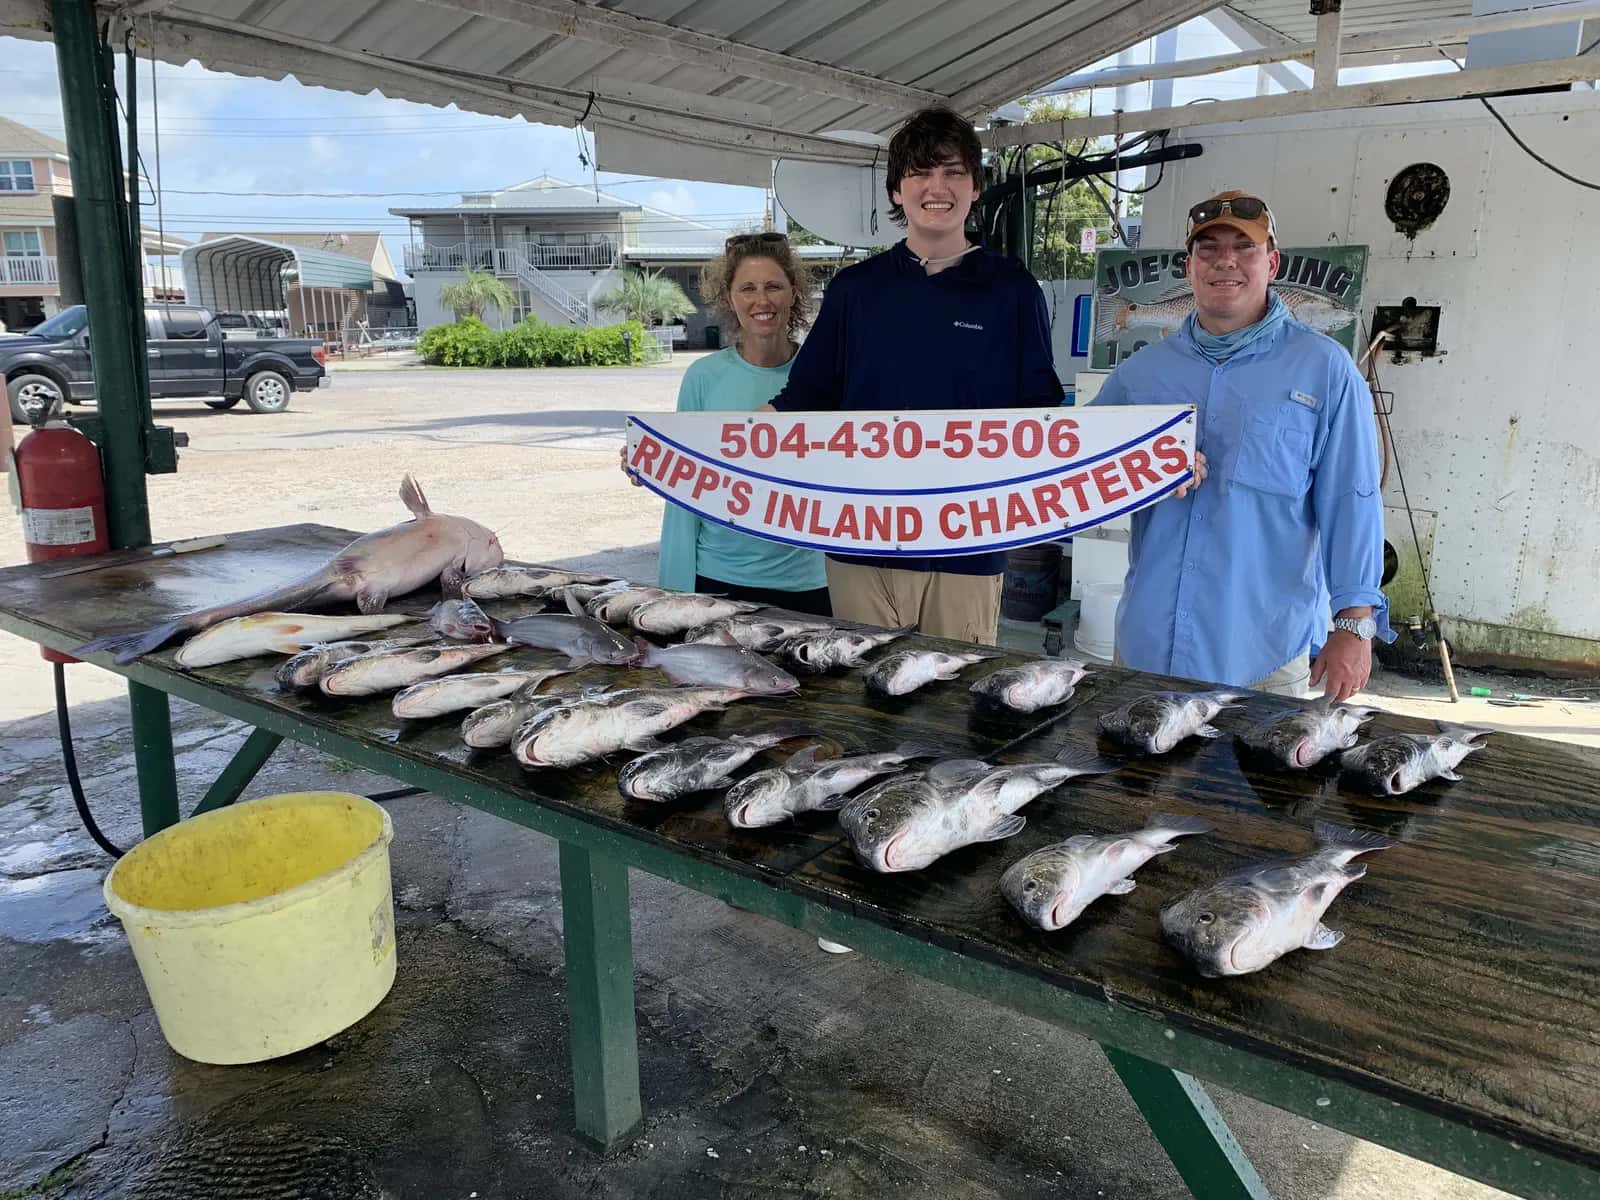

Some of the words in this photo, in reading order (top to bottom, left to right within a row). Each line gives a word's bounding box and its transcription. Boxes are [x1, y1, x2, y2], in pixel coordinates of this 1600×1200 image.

[1102, 251, 1189, 296] JOE'S
[720, 419, 1080, 460] 504-430-5506
[631, 435, 753, 516] RIPP'S
[763, 492, 924, 543] INLAND
[938, 435, 1189, 541] CHARTERS
